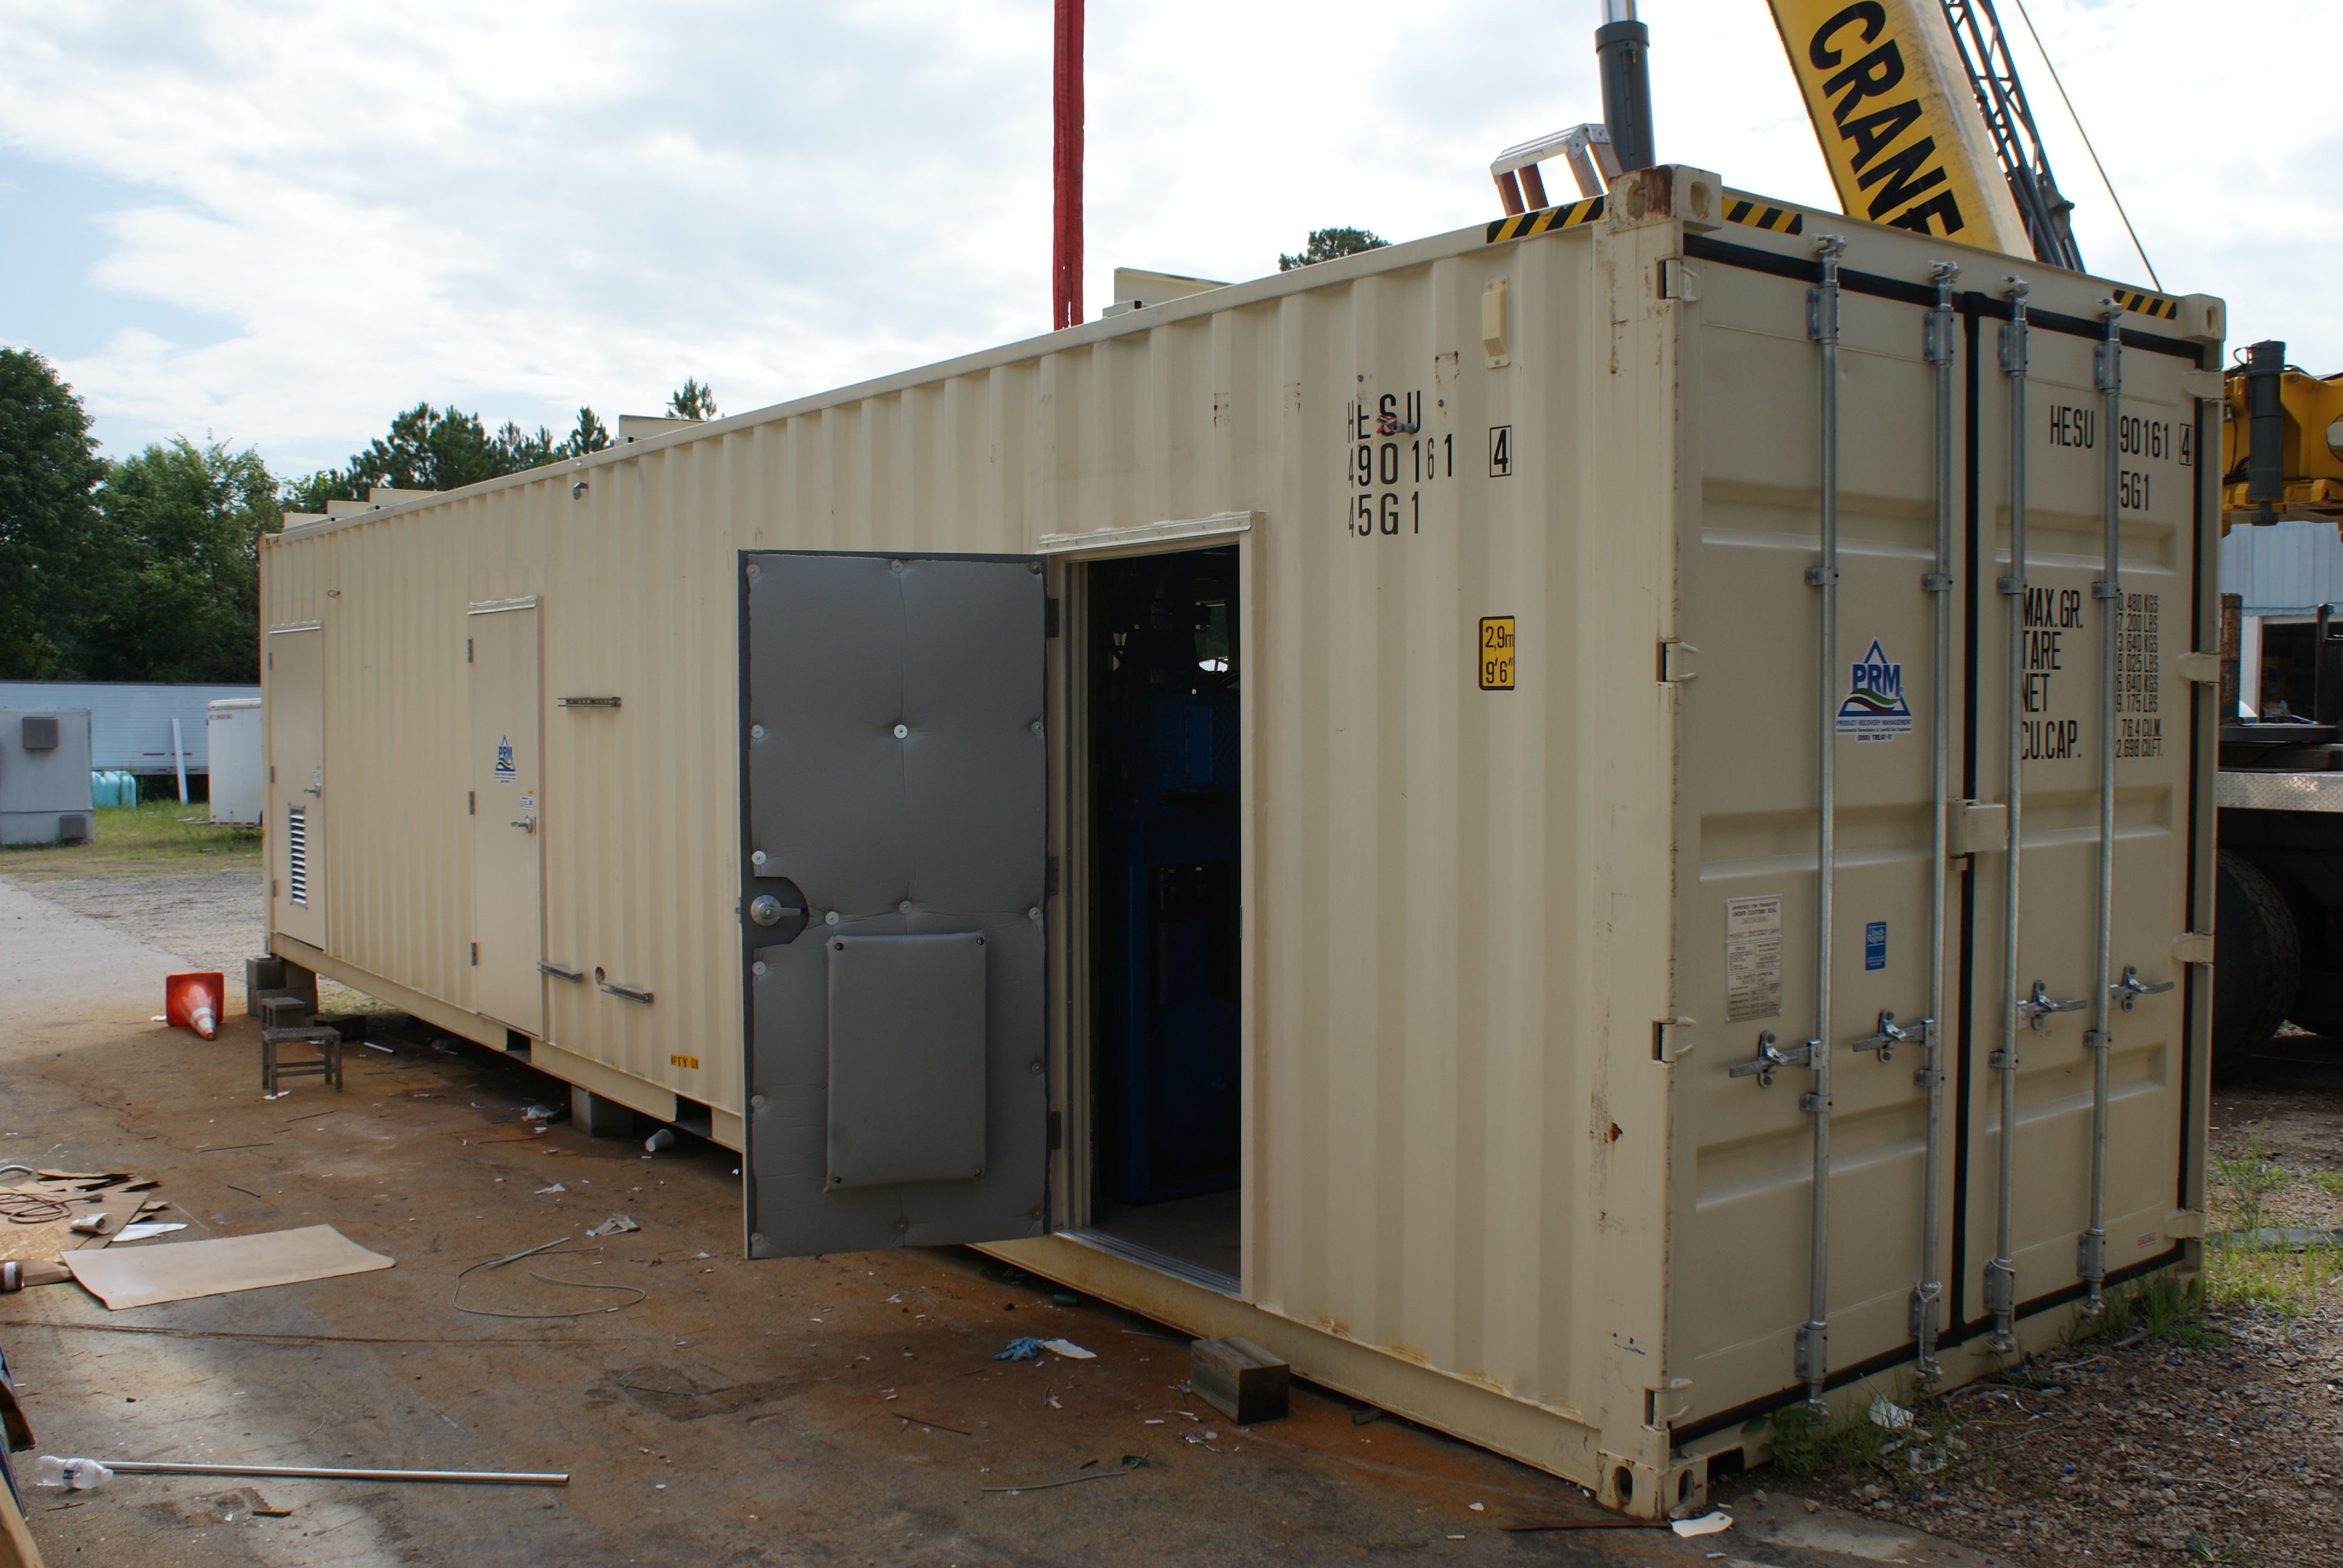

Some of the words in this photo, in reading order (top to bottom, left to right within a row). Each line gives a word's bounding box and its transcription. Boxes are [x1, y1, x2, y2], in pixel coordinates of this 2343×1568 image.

[1348, 390, 1421, 443] HESU
[2050, 405, 2094, 449] HESU
[2119, 416, 2169, 460] 90161
[2181, 427, 2191, 463] 4
[1348, 433, 1453, 489] 490161
[1493, 429, 1509, 474] 4
[2120, 470, 2150, 511] 5G1
[1348, 491, 1419, 538] 45G1
[2119, 593, 2141, 612] 0.480
[2119, 613, 2141, 632] 7.200
[2143, 614, 2158, 633] LBS
[2023, 630, 2062, 670] TARE
[2143, 654, 2158, 673] LBS
[1852, 664, 1901, 697] PRM
[2117, 673, 2141, 693] 6.840
[2117, 693, 2141, 713] 9.175
[2143, 694, 2158, 713] LBS
[2122, 718, 2139, 737] 76.4
